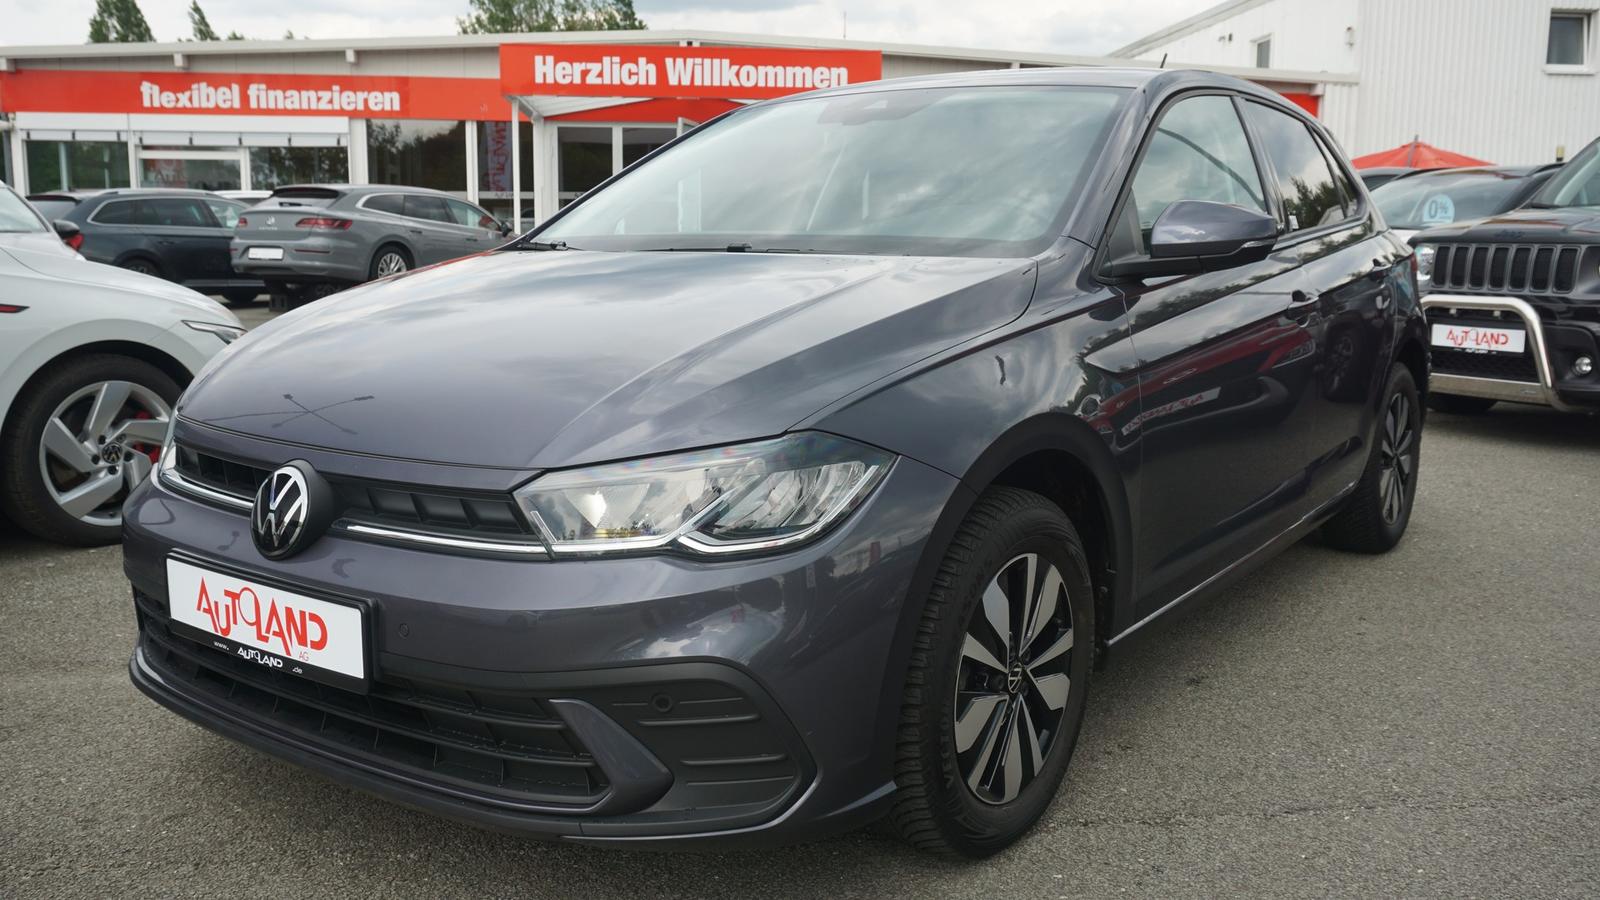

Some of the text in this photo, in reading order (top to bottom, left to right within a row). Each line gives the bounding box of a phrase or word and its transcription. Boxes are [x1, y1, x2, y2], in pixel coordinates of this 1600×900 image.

[534, 55, 848, 88] Herzlich Willkommen
[140, 80, 401, 112] flexibel finanzieren
[197, 576, 328, 657] AUTOLAND
